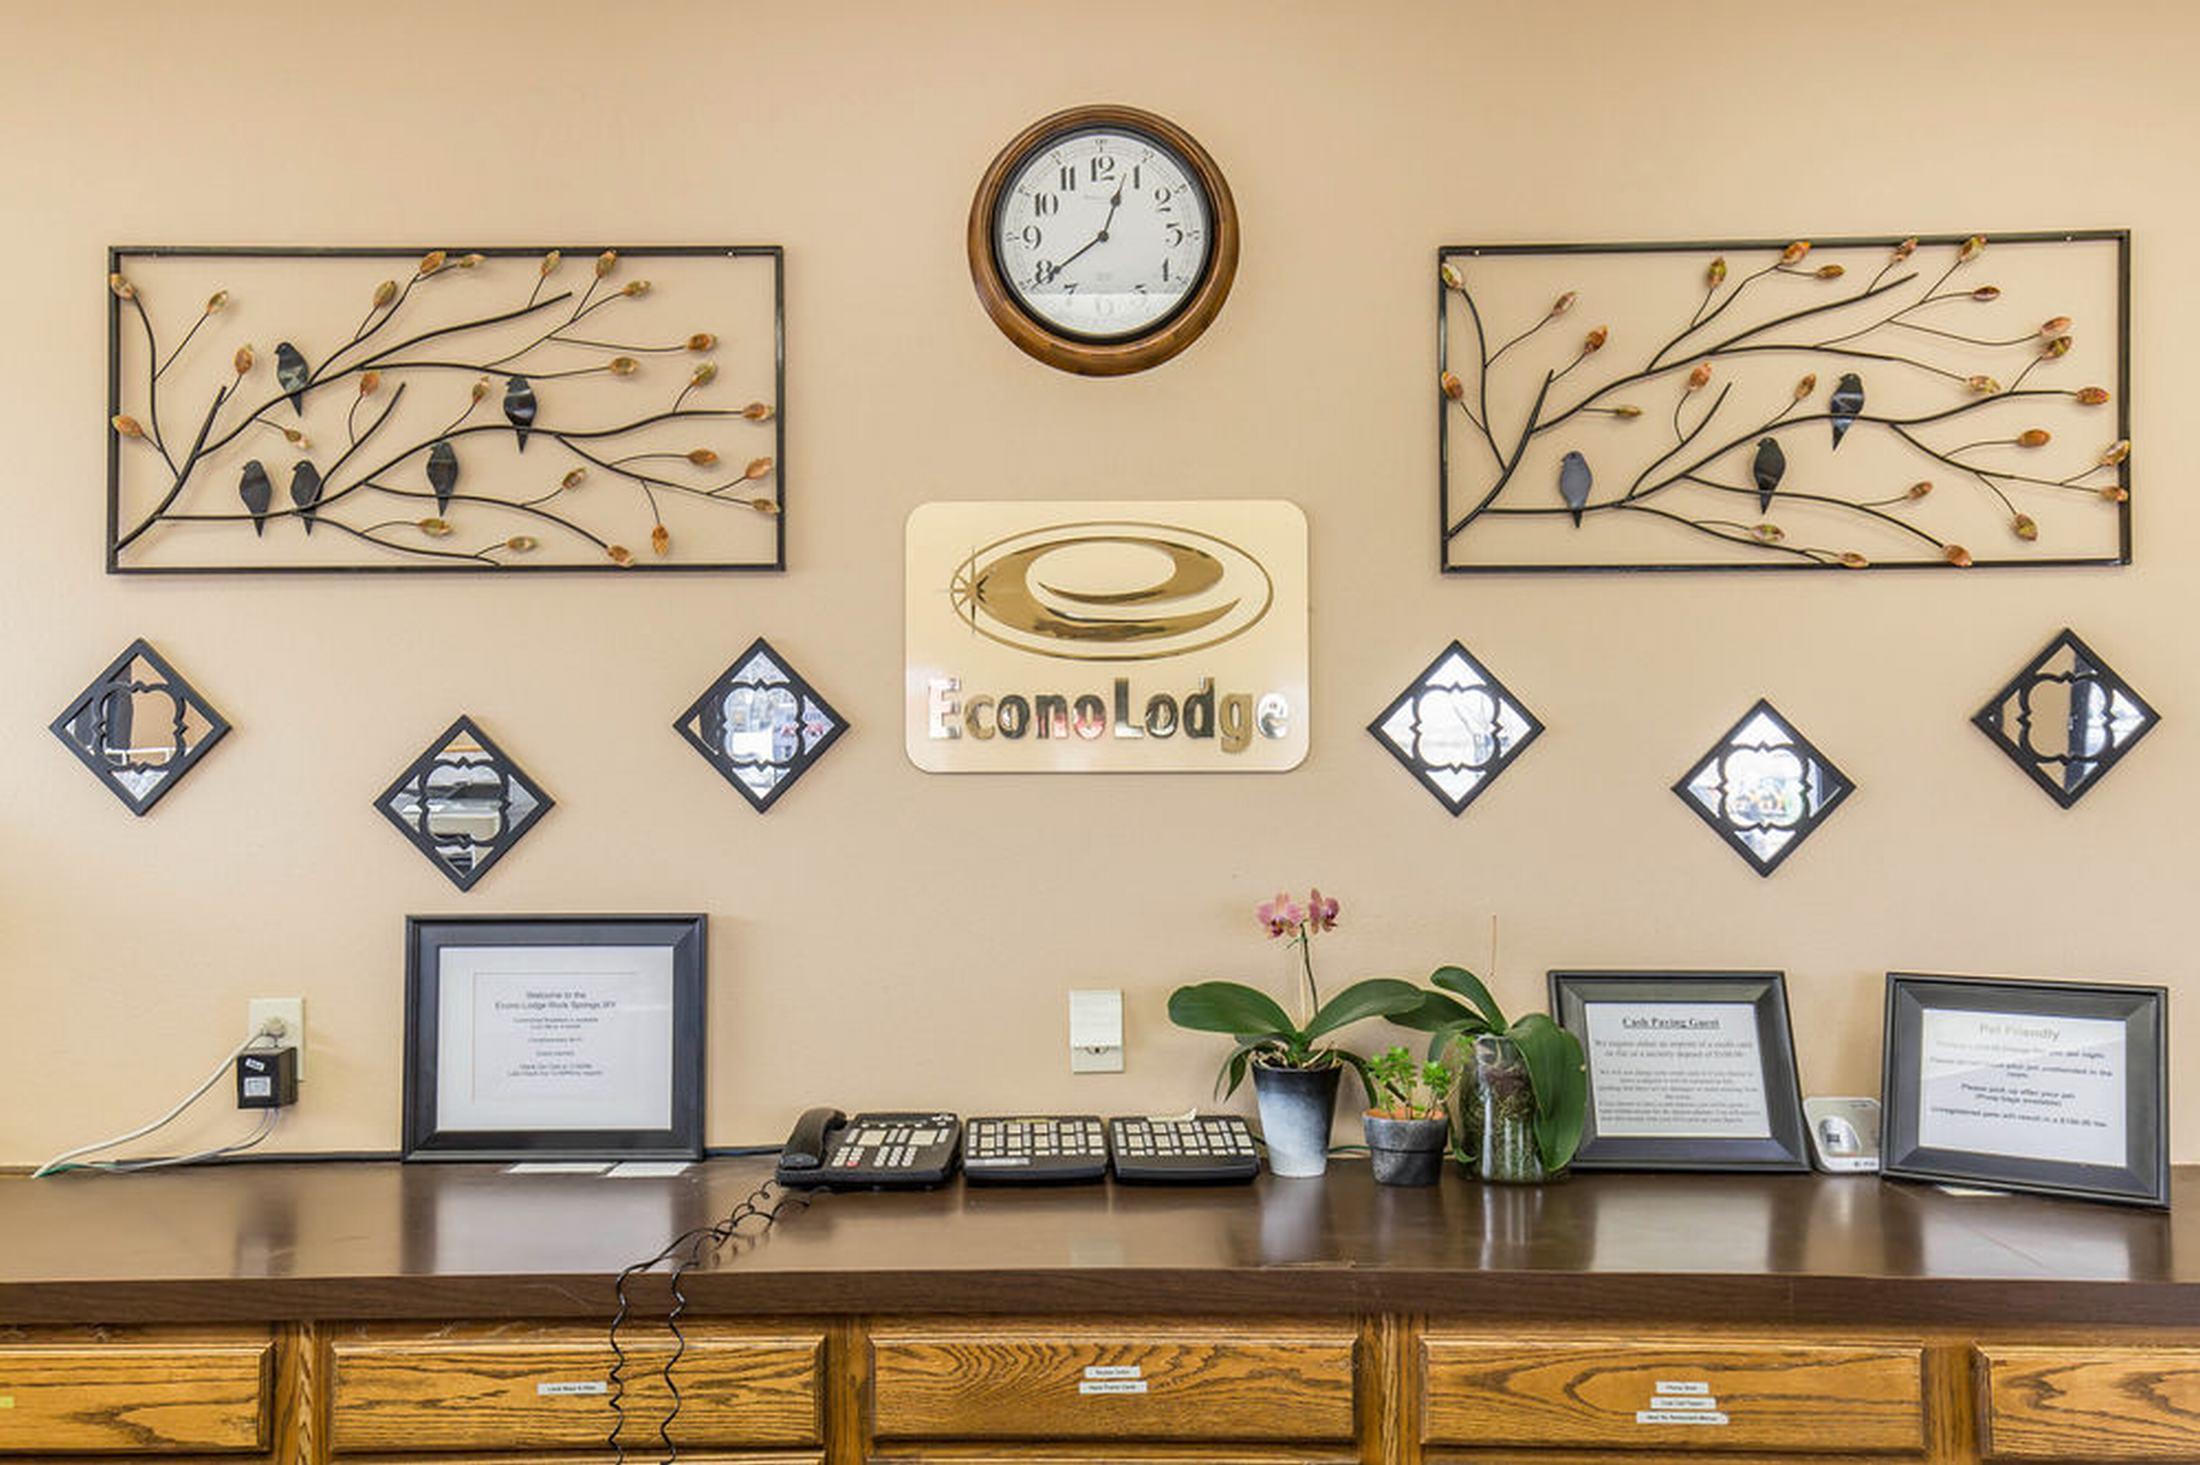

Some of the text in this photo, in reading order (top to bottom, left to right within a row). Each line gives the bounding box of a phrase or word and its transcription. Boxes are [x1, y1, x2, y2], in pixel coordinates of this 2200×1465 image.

[1061, 165, 1076, 191] 11
[1090, 156, 1115, 182] 12
[1133, 165, 1140, 190] 1
[1035, 192, 1059, 217] 10
[1154, 187, 1171, 212] 2
[1022, 225, 1042, 250] 9
[1035, 260, 1054, 285] 8
[927, 676, 1290, 755] EconoLodge
[1622, 1017, 1720, 1030] Cash Paying Guest
[2004, 1025, 2060, 1042] Friendly
